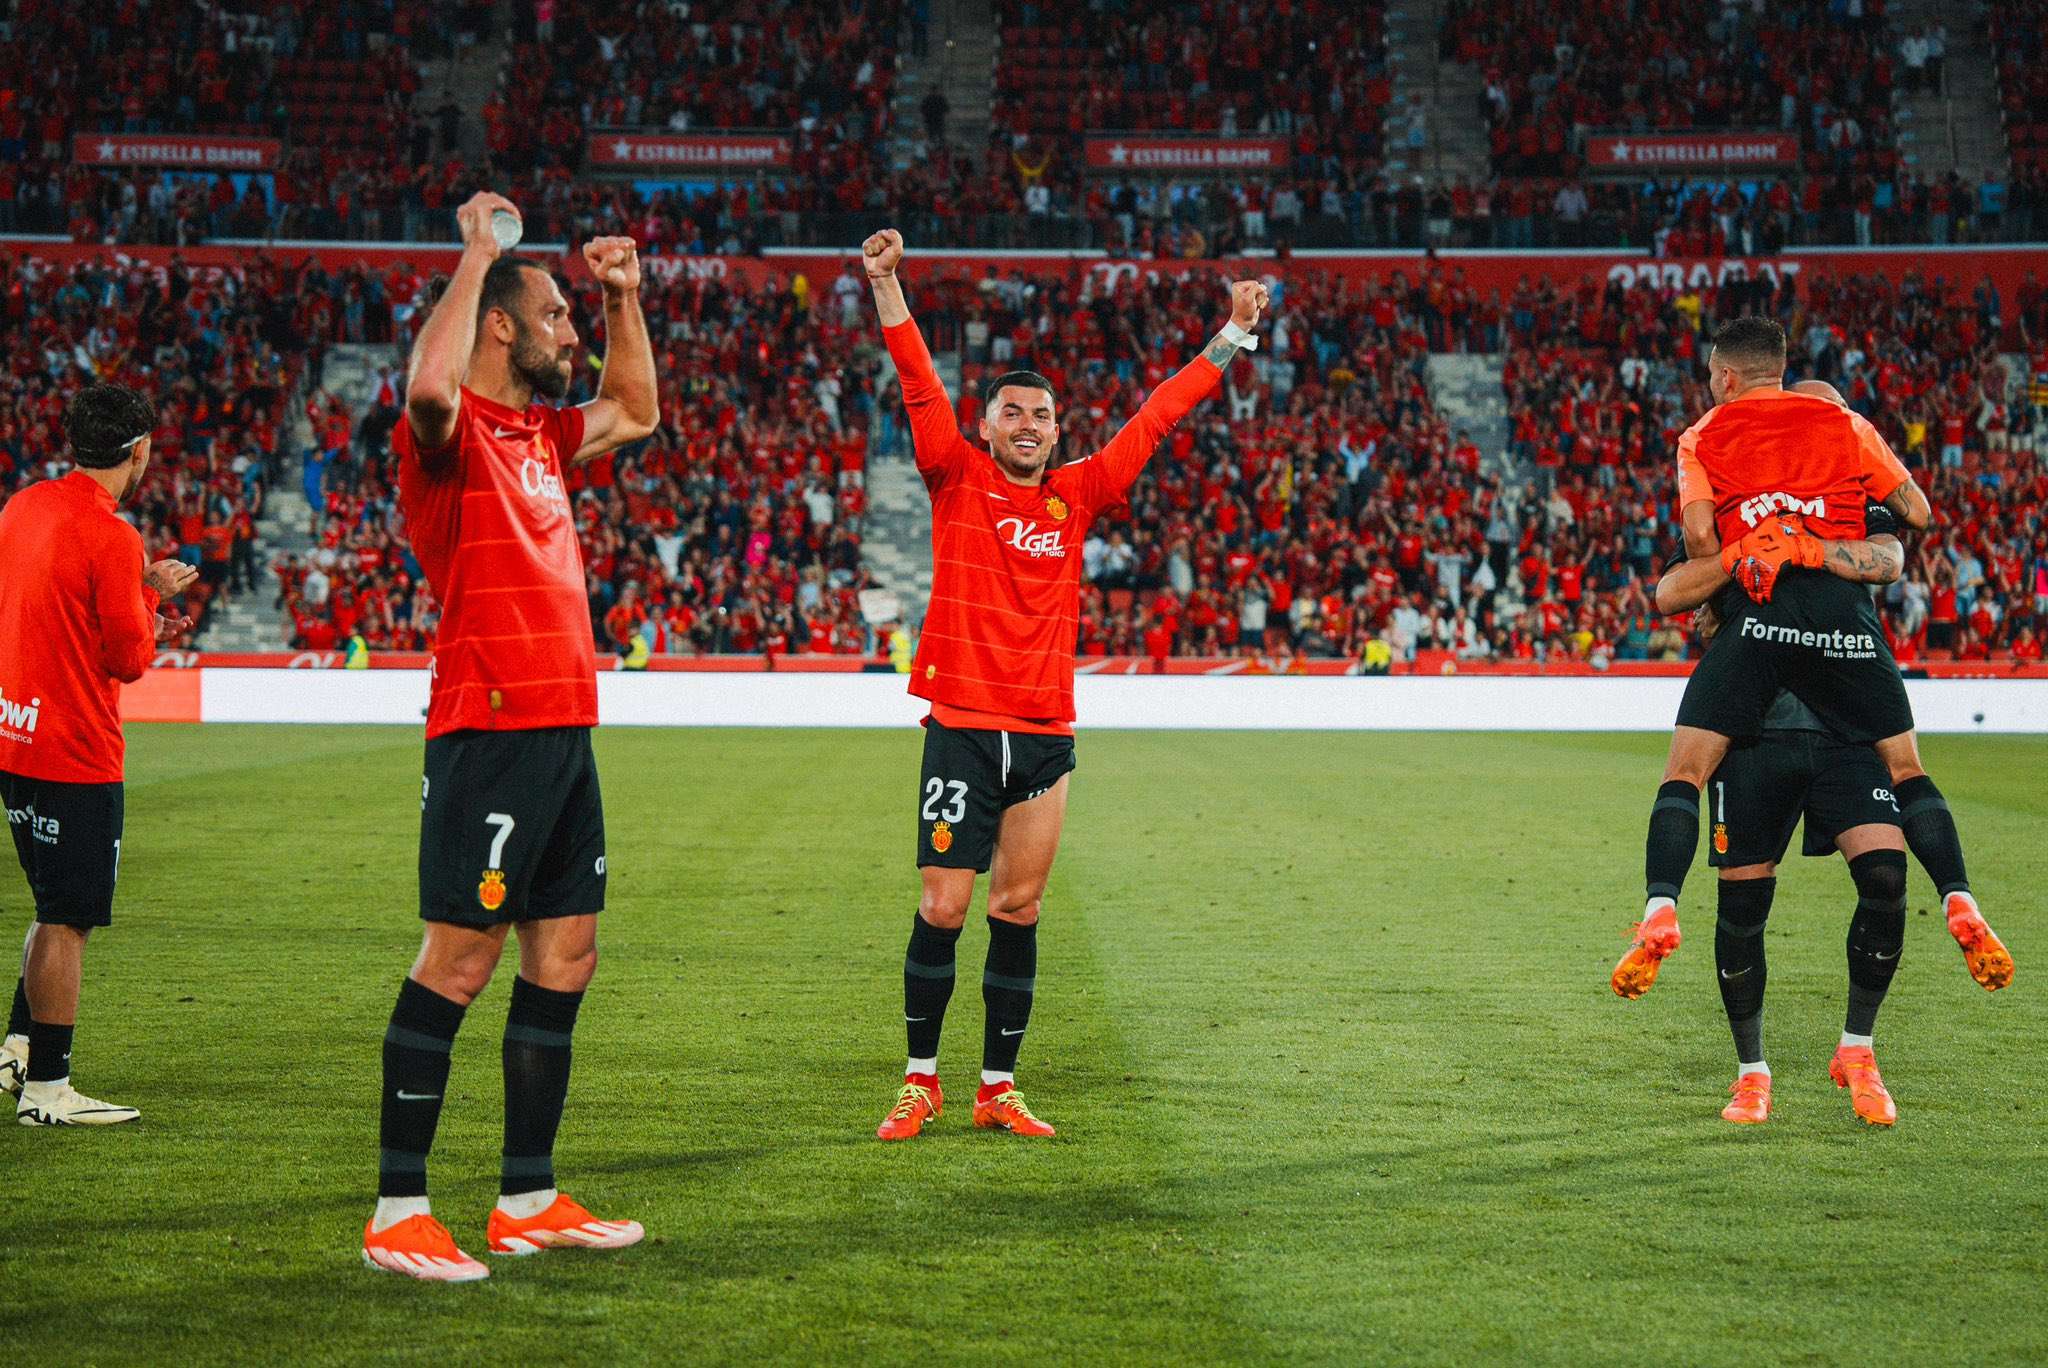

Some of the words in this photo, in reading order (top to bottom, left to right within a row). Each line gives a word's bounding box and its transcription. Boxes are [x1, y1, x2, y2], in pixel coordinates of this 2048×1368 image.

[120, 143, 201, 161] ESTRELLA
[206, 146, 262, 163] DAMM
[636, 144, 718, 161] ESTRELLA
[720, 146, 774, 161] DAMM
[1133, 148, 1214, 163] ESTRELLA
[1216, 148, 1271, 162] DAMM
[1635, 144, 1719, 161] ESTRELLA
[1722, 143, 1778, 160] DAMM
[1740, 616, 1876, 650] Formentera
[1846, 650, 1877, 659] Balears
[922, 776, 969, 824] 23
[1715, 781, 1725, 823] 1
[485, 812, 516, 869] 7
